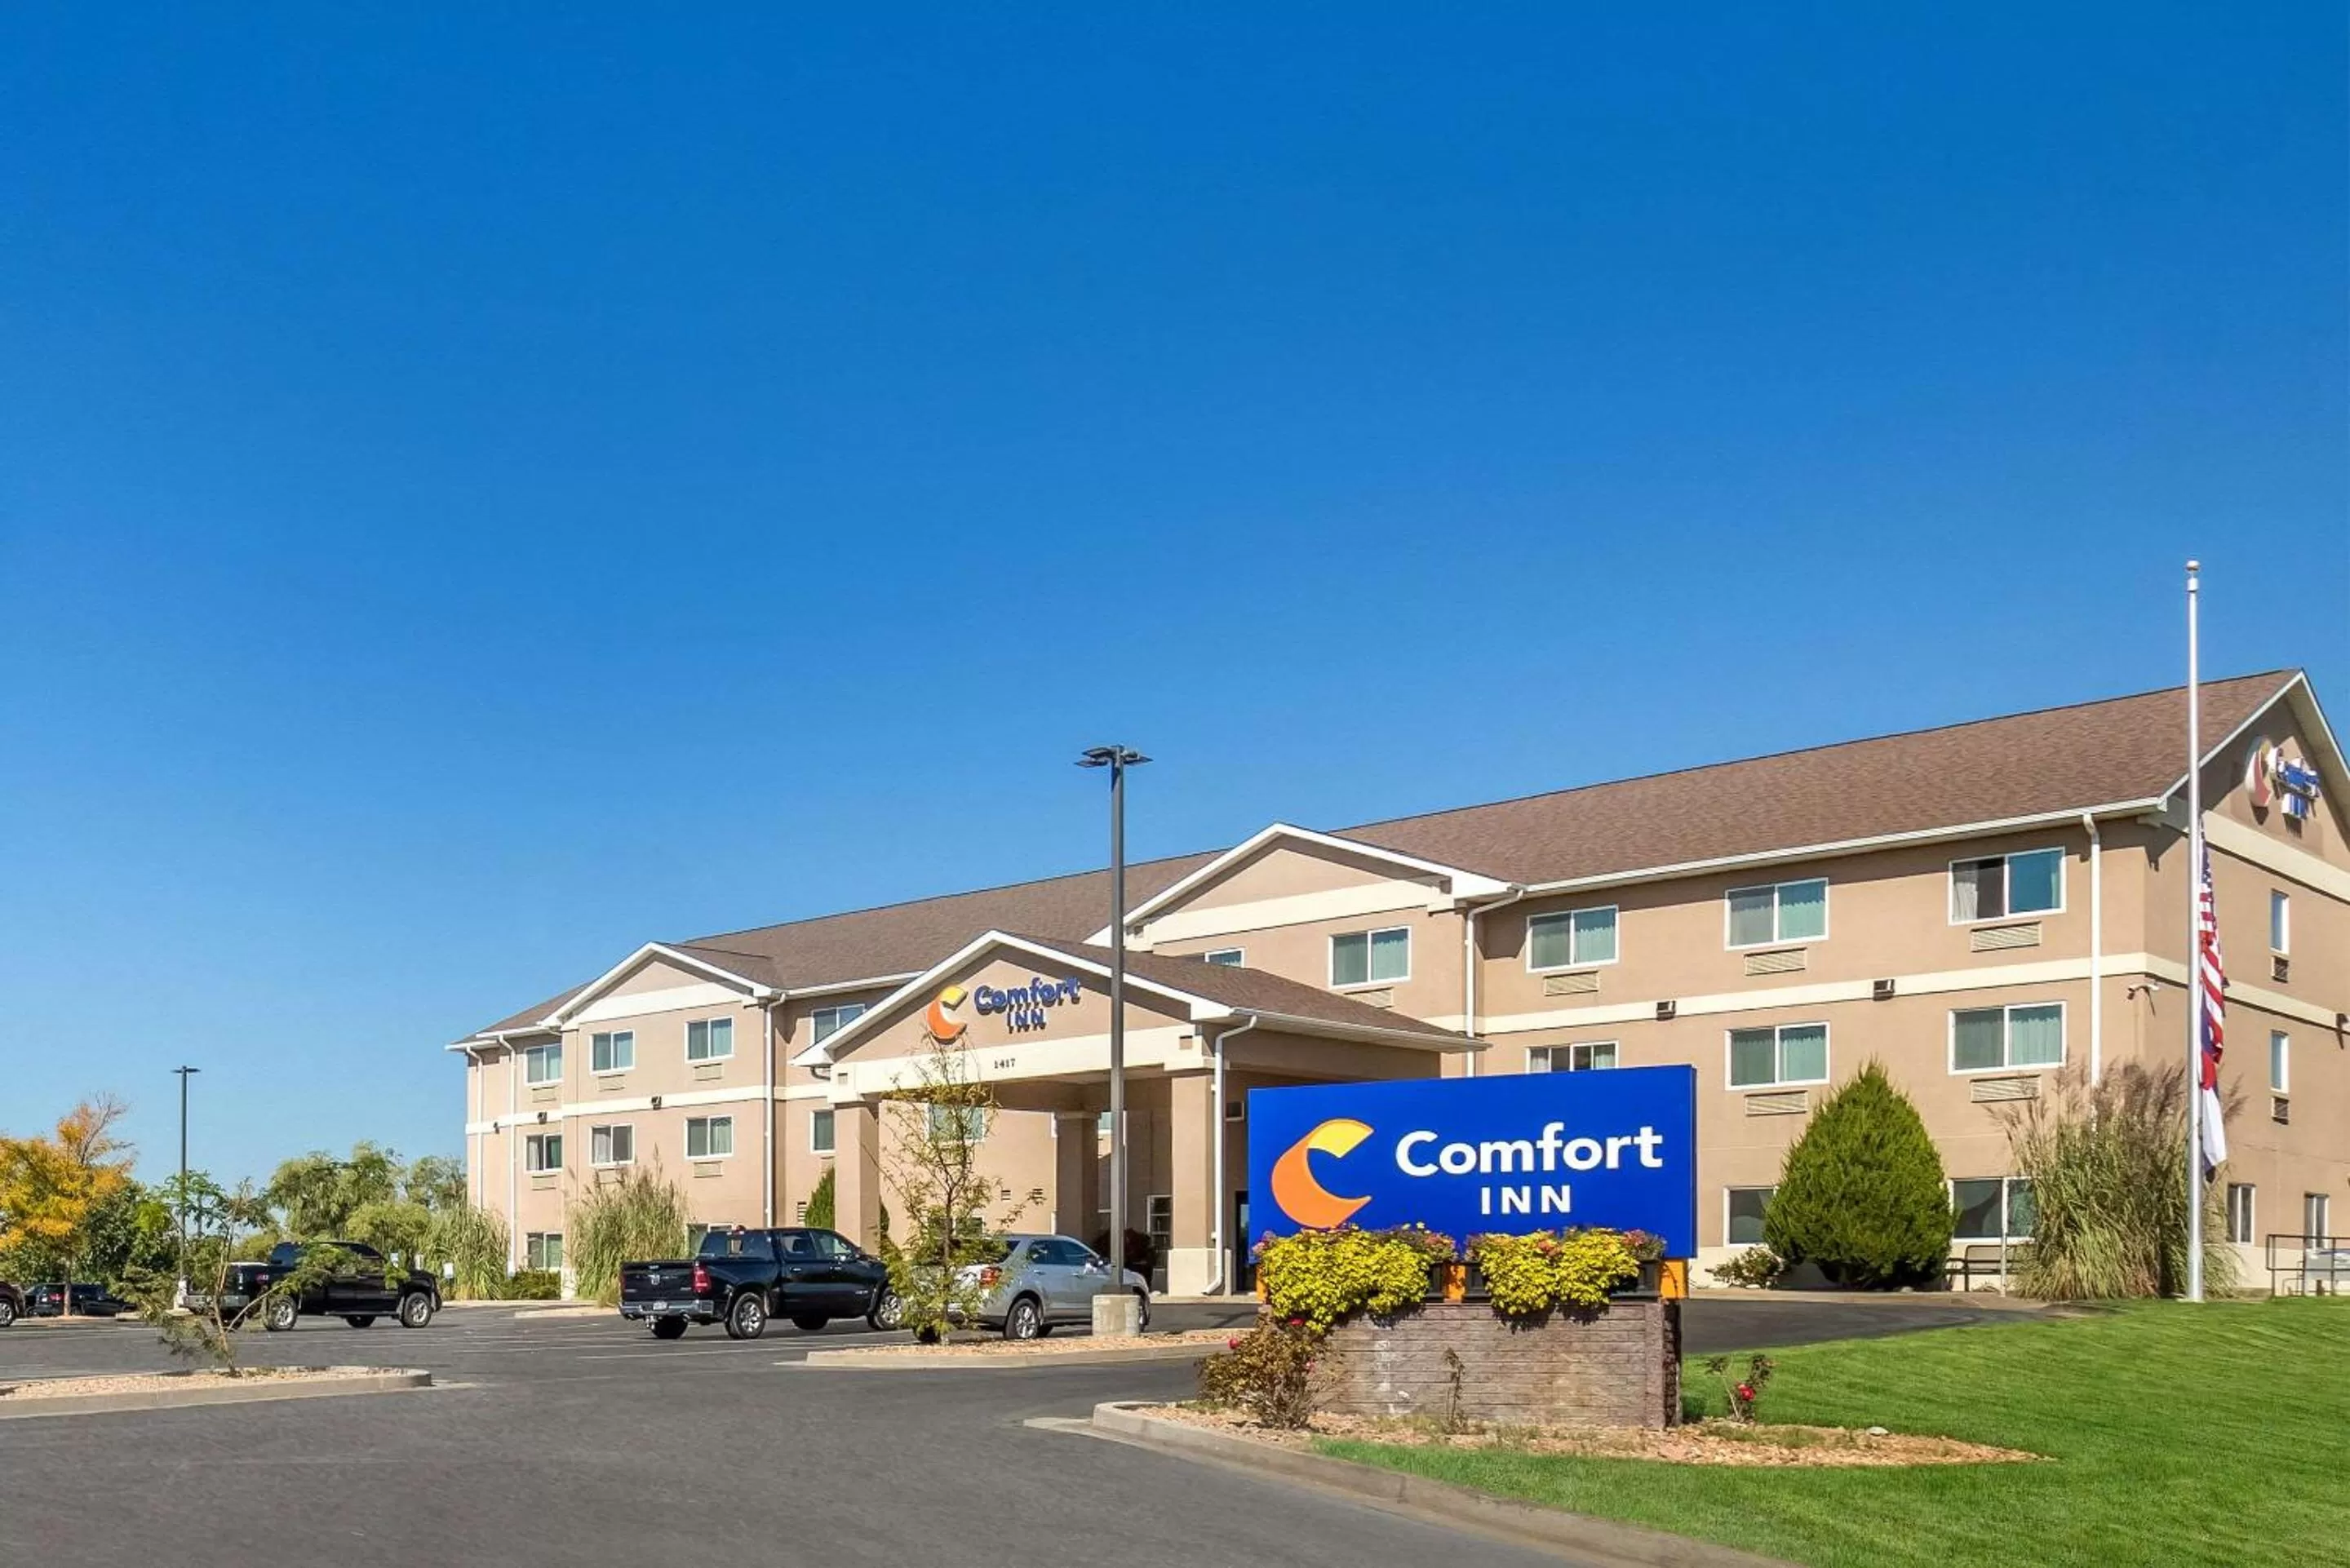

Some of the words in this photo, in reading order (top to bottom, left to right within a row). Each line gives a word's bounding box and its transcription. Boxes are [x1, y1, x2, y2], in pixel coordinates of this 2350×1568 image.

[974, 977, 1080, 1012] Comfort
[1007, 1008, 1045, 1031] INN
[994, 1058, 1015, 1070] 1417
[1395, 1122, 1663, 1177] Comfort
[1481, 1185, 1572, 1215] INN
